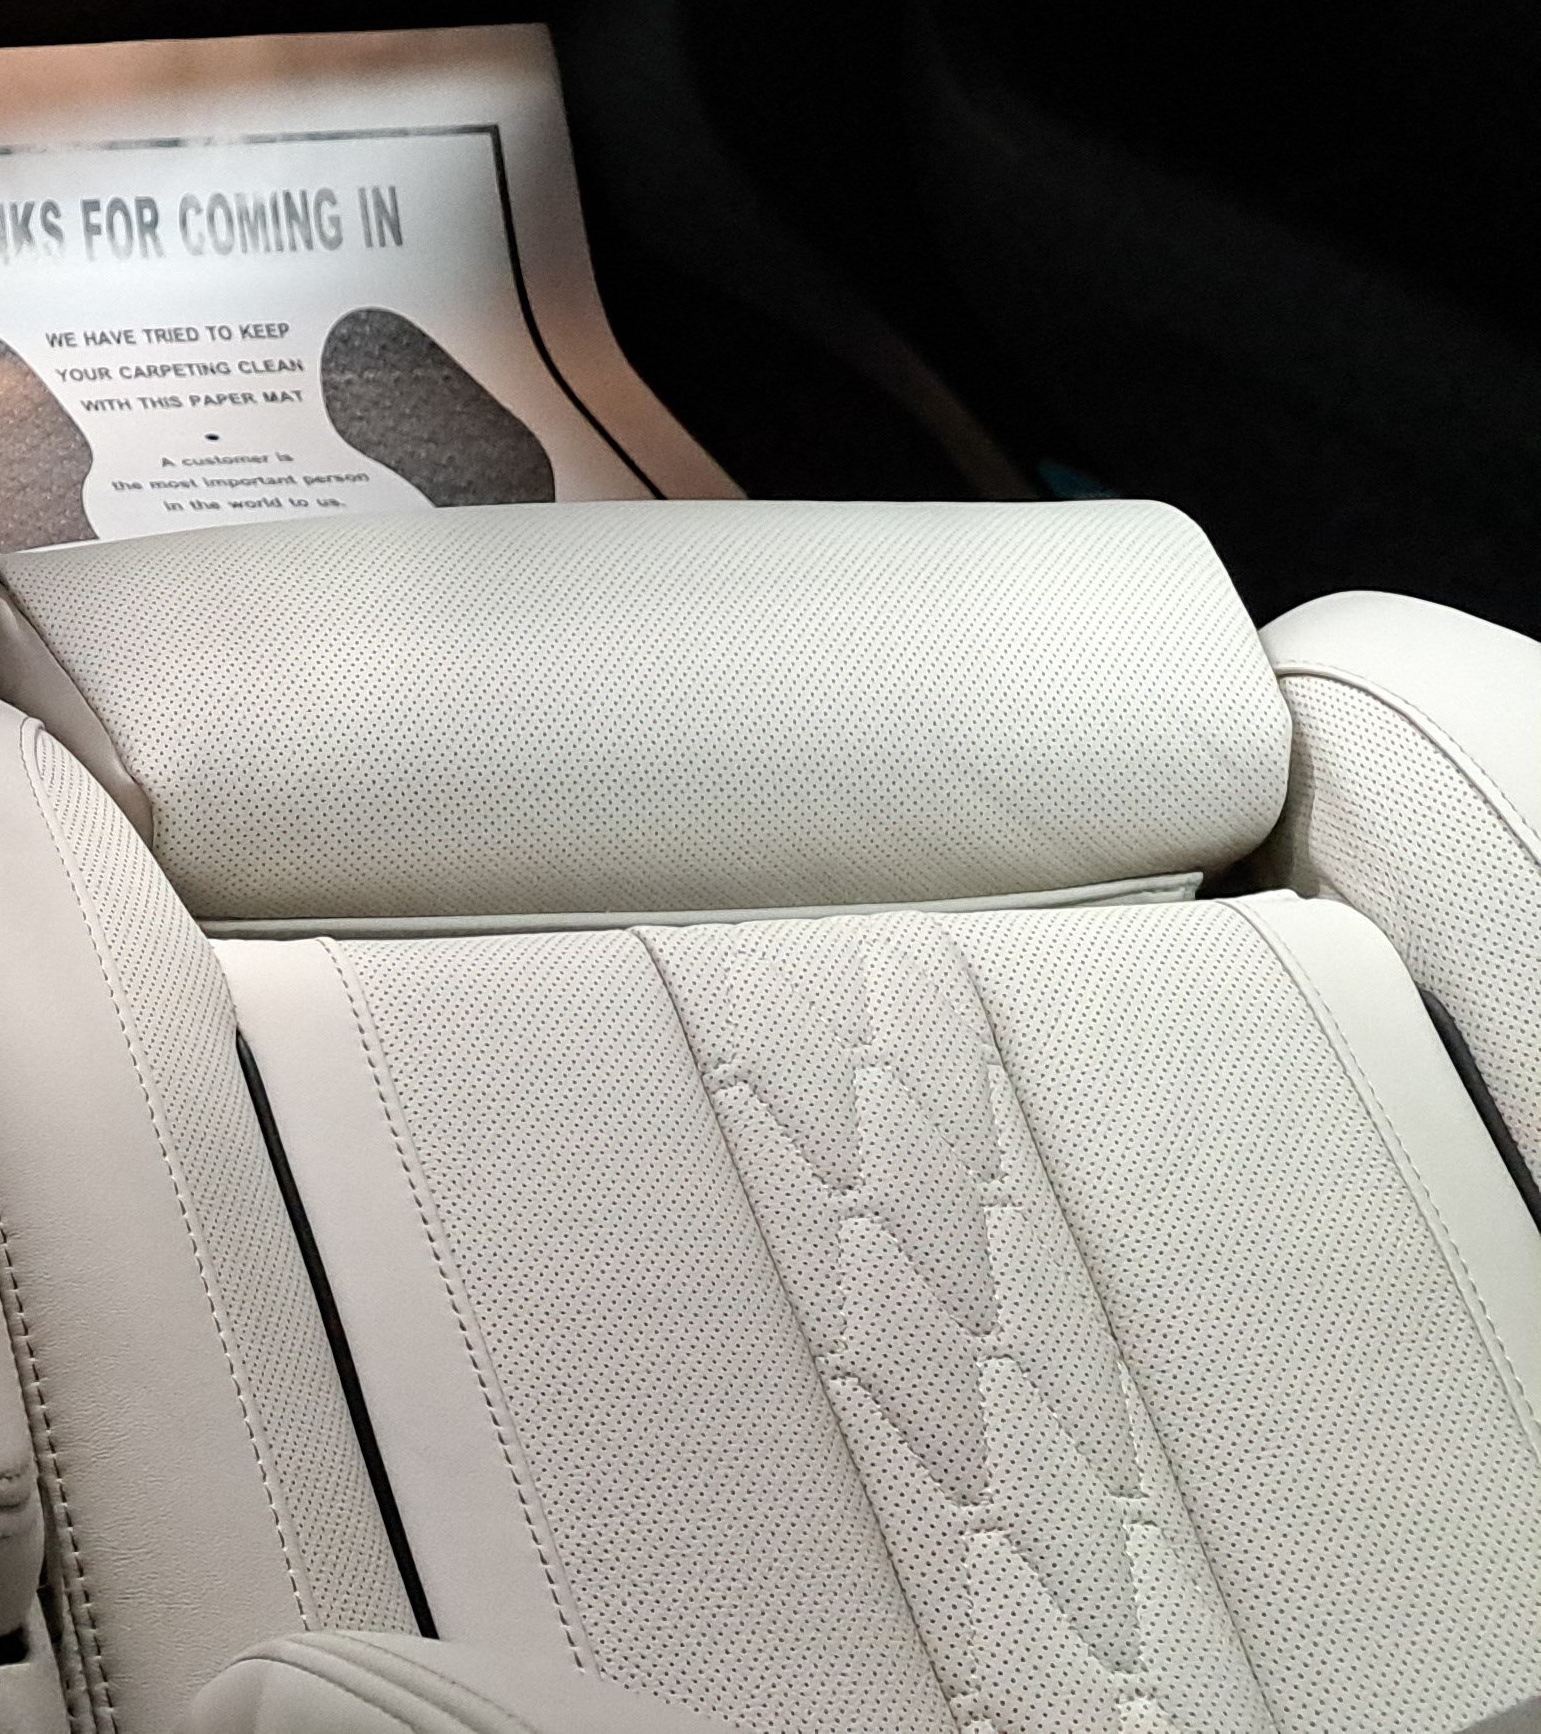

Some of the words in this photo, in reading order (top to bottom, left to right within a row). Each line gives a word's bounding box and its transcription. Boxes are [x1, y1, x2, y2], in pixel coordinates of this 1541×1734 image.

[80, 196, 165, 261] FOR
[179, 187, 343, 256] COMING
[358, 185, 404, 249] IN
[46, 331, 78, 349] WE
[84, 329, 137, 347] HAVE
[142, 326, 199, 344] TRIED
[206, 324, 232, 341] TO
[239, 322, 290, 339] KEEP
[56, 367, 112, 383] YOUR
[119, 361, 231, 379] CARPETING
[238, 358, 305, 375] CLEAN
[80, 397, 133, 413] WITH
[138, 395, 183, 410] THIS
[189, 392, 258, 408] PAPER
[263, 389, 305, 404] MAT
[162, 456, 176, 468] A
[182, 452, 268, 468] customer
[276, 451, 295, 464] is
[111, 479, 144, 492] the
[150, 476, 198, 489] most
[202, 474, 299, 489] important
[303, 471, 371, 486] person
[163, 499, 183, 512] in
[189, 497, 221, 511] the
[229, 495, 282, 509] world
[288, 495, 308, 508] to
[317, 496, 347, 508] us.
